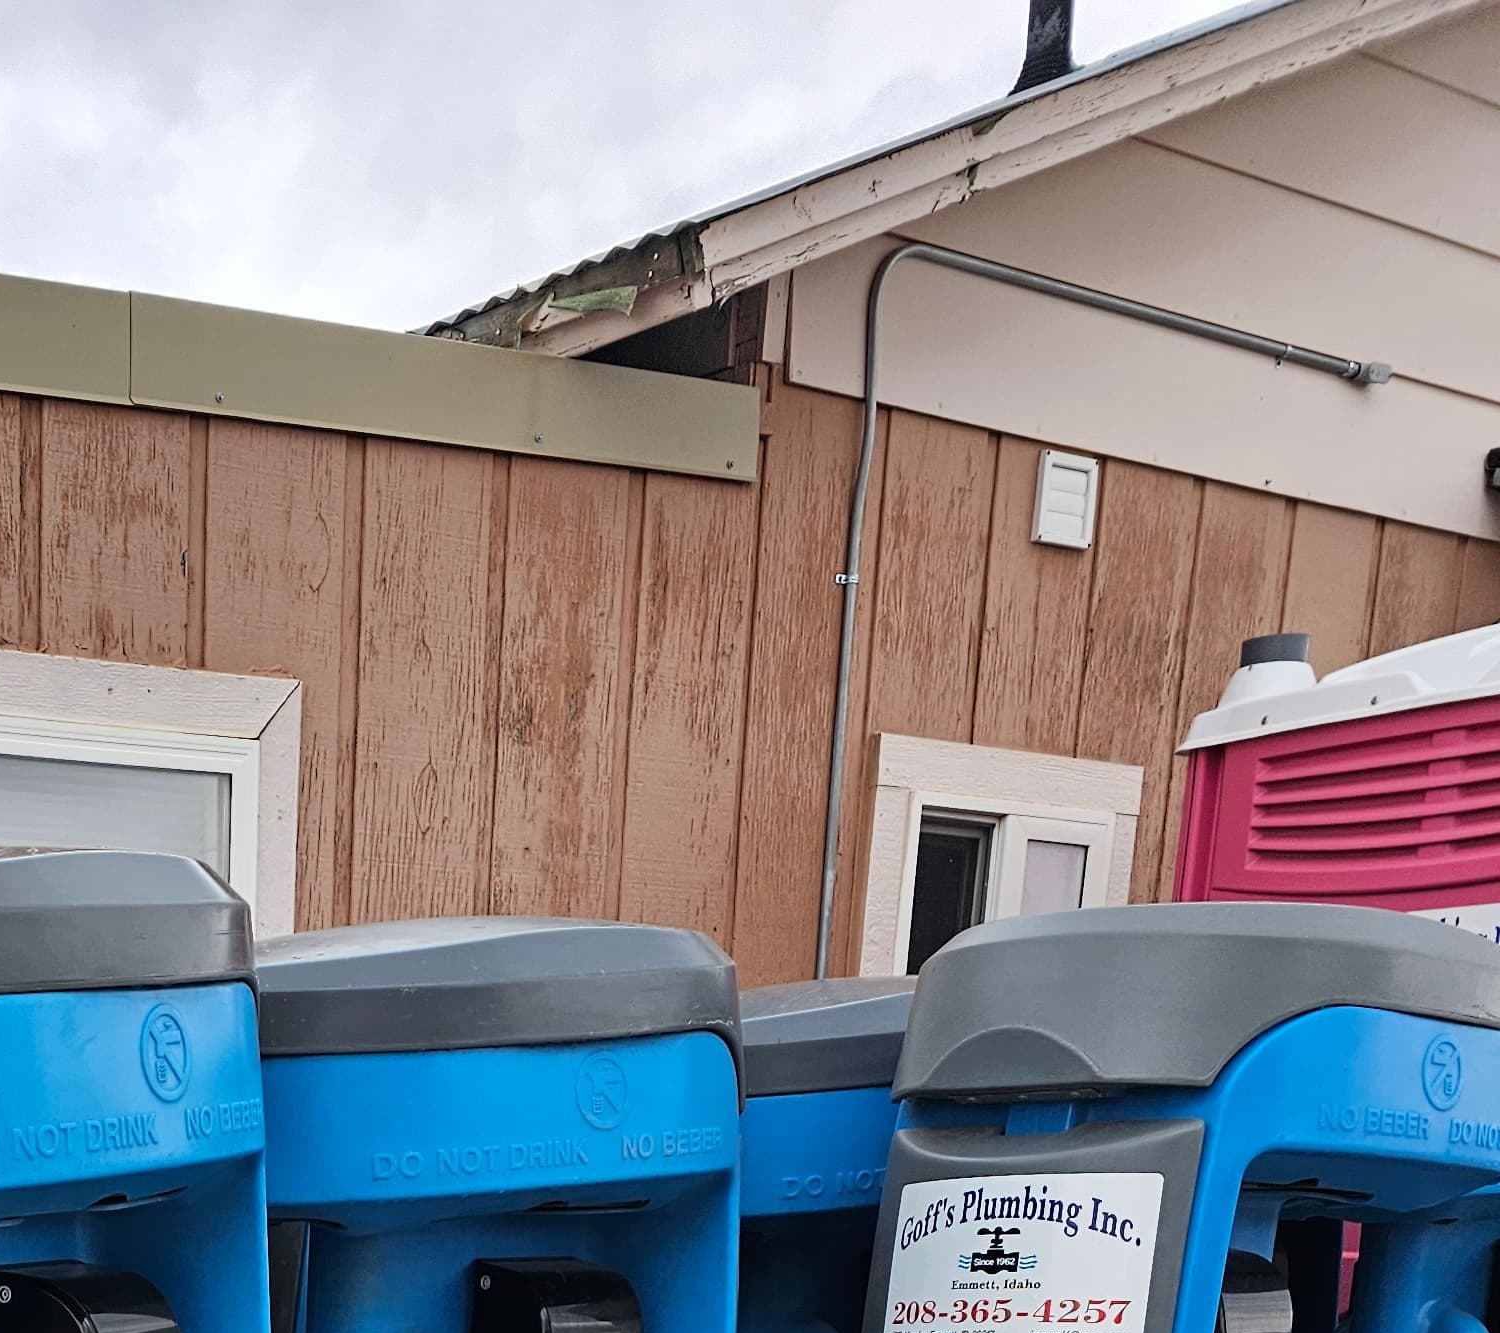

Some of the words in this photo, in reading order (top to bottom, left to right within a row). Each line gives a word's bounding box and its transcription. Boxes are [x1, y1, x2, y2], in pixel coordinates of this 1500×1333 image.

[12, 1122, 77, 1163] NOT
[85, 1113, 159, 1154] DRINK
[184, 1104, 213, 1142] NO
[1317, 1103, 1357, 1132] NO
[1364, 1106, 1428, 1141] BEBER
[1448, 1119, 1473, 1145] DO
[1475, 1122, 1500, 1150] NO
[371, 1150, 425, 1181] DO
[436, 1145, 499, 1178] NOT
[509, 1138, 589, 1172] DRINK
[622, 1133, 654, 1161] NO
[662, 1127, 721, 1158] BEBER
[781, 1175, 824, 1201] DO
[900, 1197, 956, 1251] Goff's
[960, 1185, 1083, 1238] Plumbing
[1088, 1197, 1141, 1247] Inc.
[974, 1258, 994, 1266] Since
[996, 1257, 1015, 1266] 1962
[951, 1280, 1000, 1291] Emmett,
[1003, 1279, 1042, 1290] Idaho
[892, 1298, 1132, 1326] 208-365-4257
